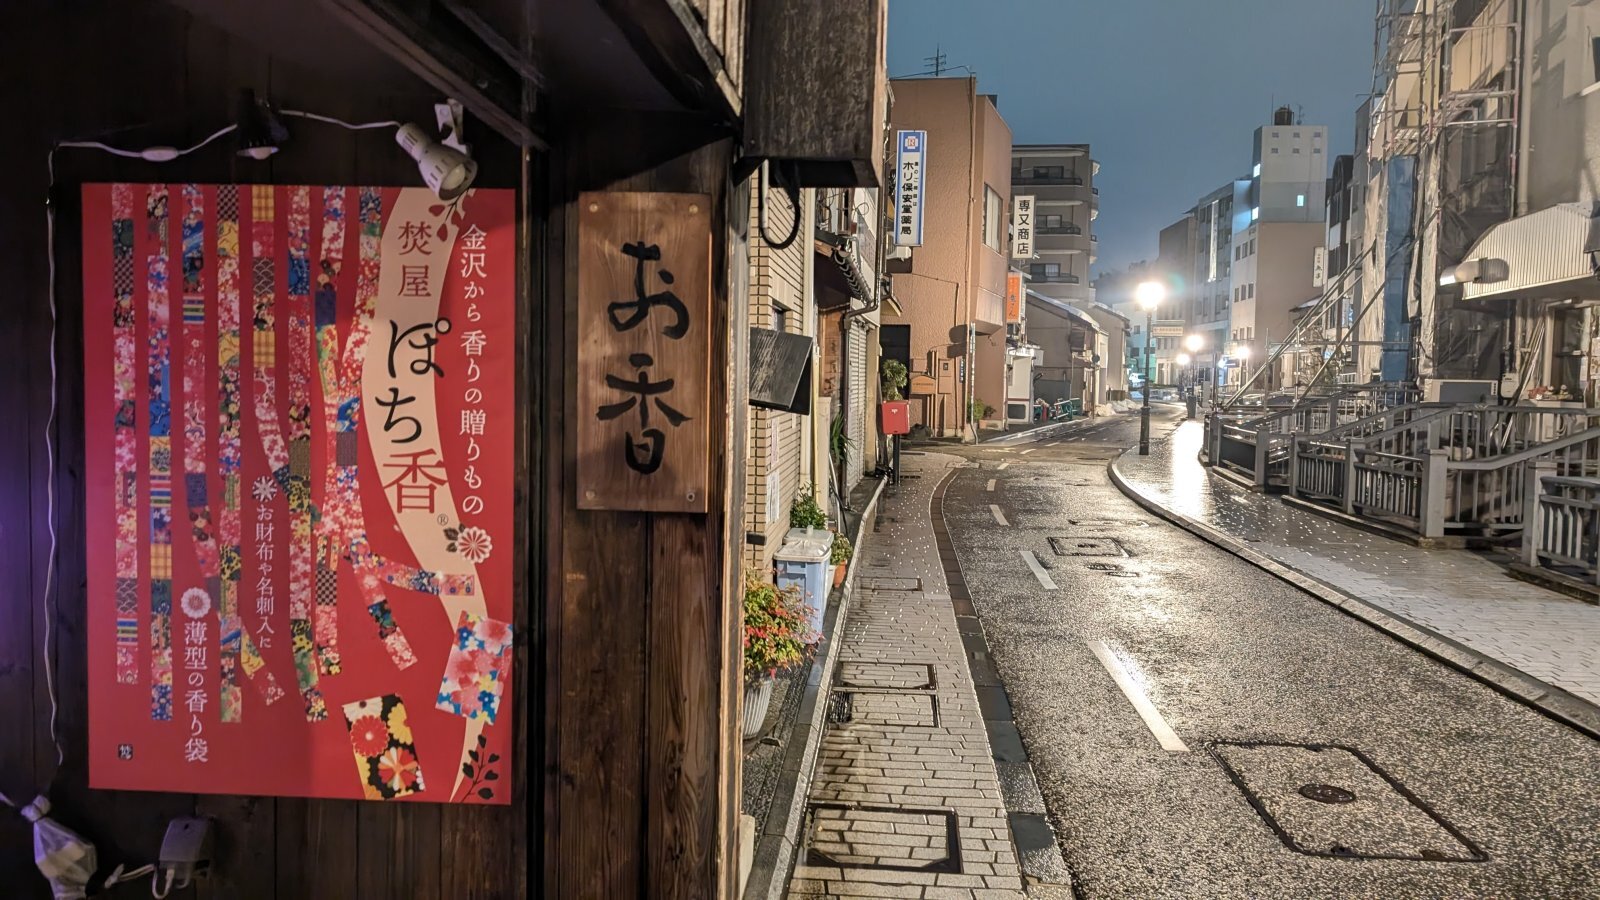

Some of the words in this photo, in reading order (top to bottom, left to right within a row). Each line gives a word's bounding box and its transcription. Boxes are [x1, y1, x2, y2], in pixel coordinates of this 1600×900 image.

[397, 221, 433, 297] 焚屋
[901, 161, 914, 235] ホリ保安堂薬局
[1017, 199, 1030, 255] 専又商店
[374, 317, 452, 514] ぽち香
[459, 223, 488, 515] 金沢から香りの贈りもの
[596, 241, 692, 475] お香
[255, 504, 275, 649] お財布や名刺入に
[184, 622, 209, 763] 薄型の香り袋
